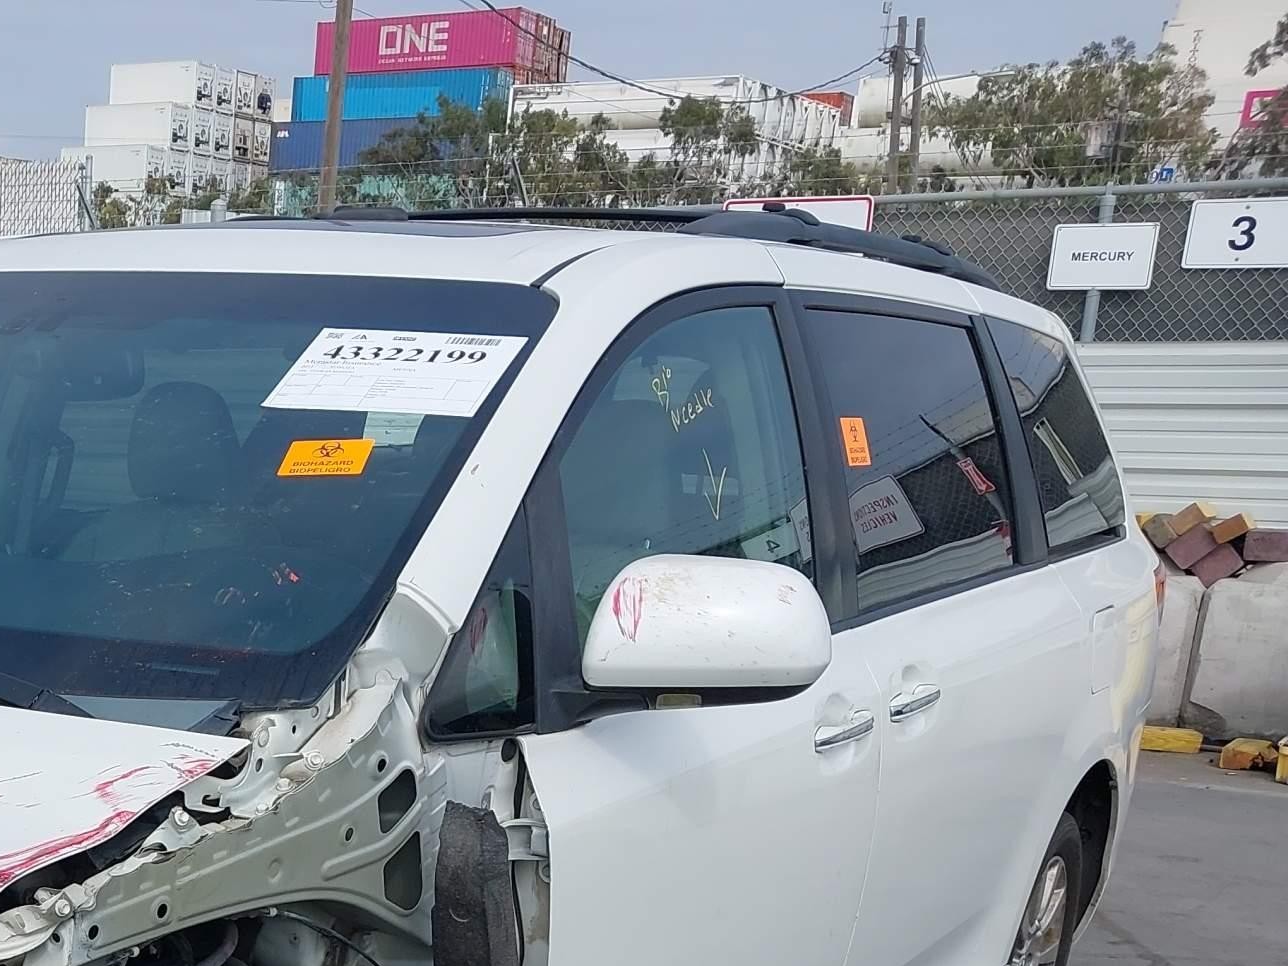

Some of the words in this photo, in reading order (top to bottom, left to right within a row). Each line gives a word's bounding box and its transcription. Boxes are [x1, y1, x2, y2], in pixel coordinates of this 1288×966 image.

[379, 21, 450, 55] ONE
[1228, 216, 1257, 251] 3
[1071, 251, 1135, 261] MERCURY
[323, 345, 487, 364] 43322199
